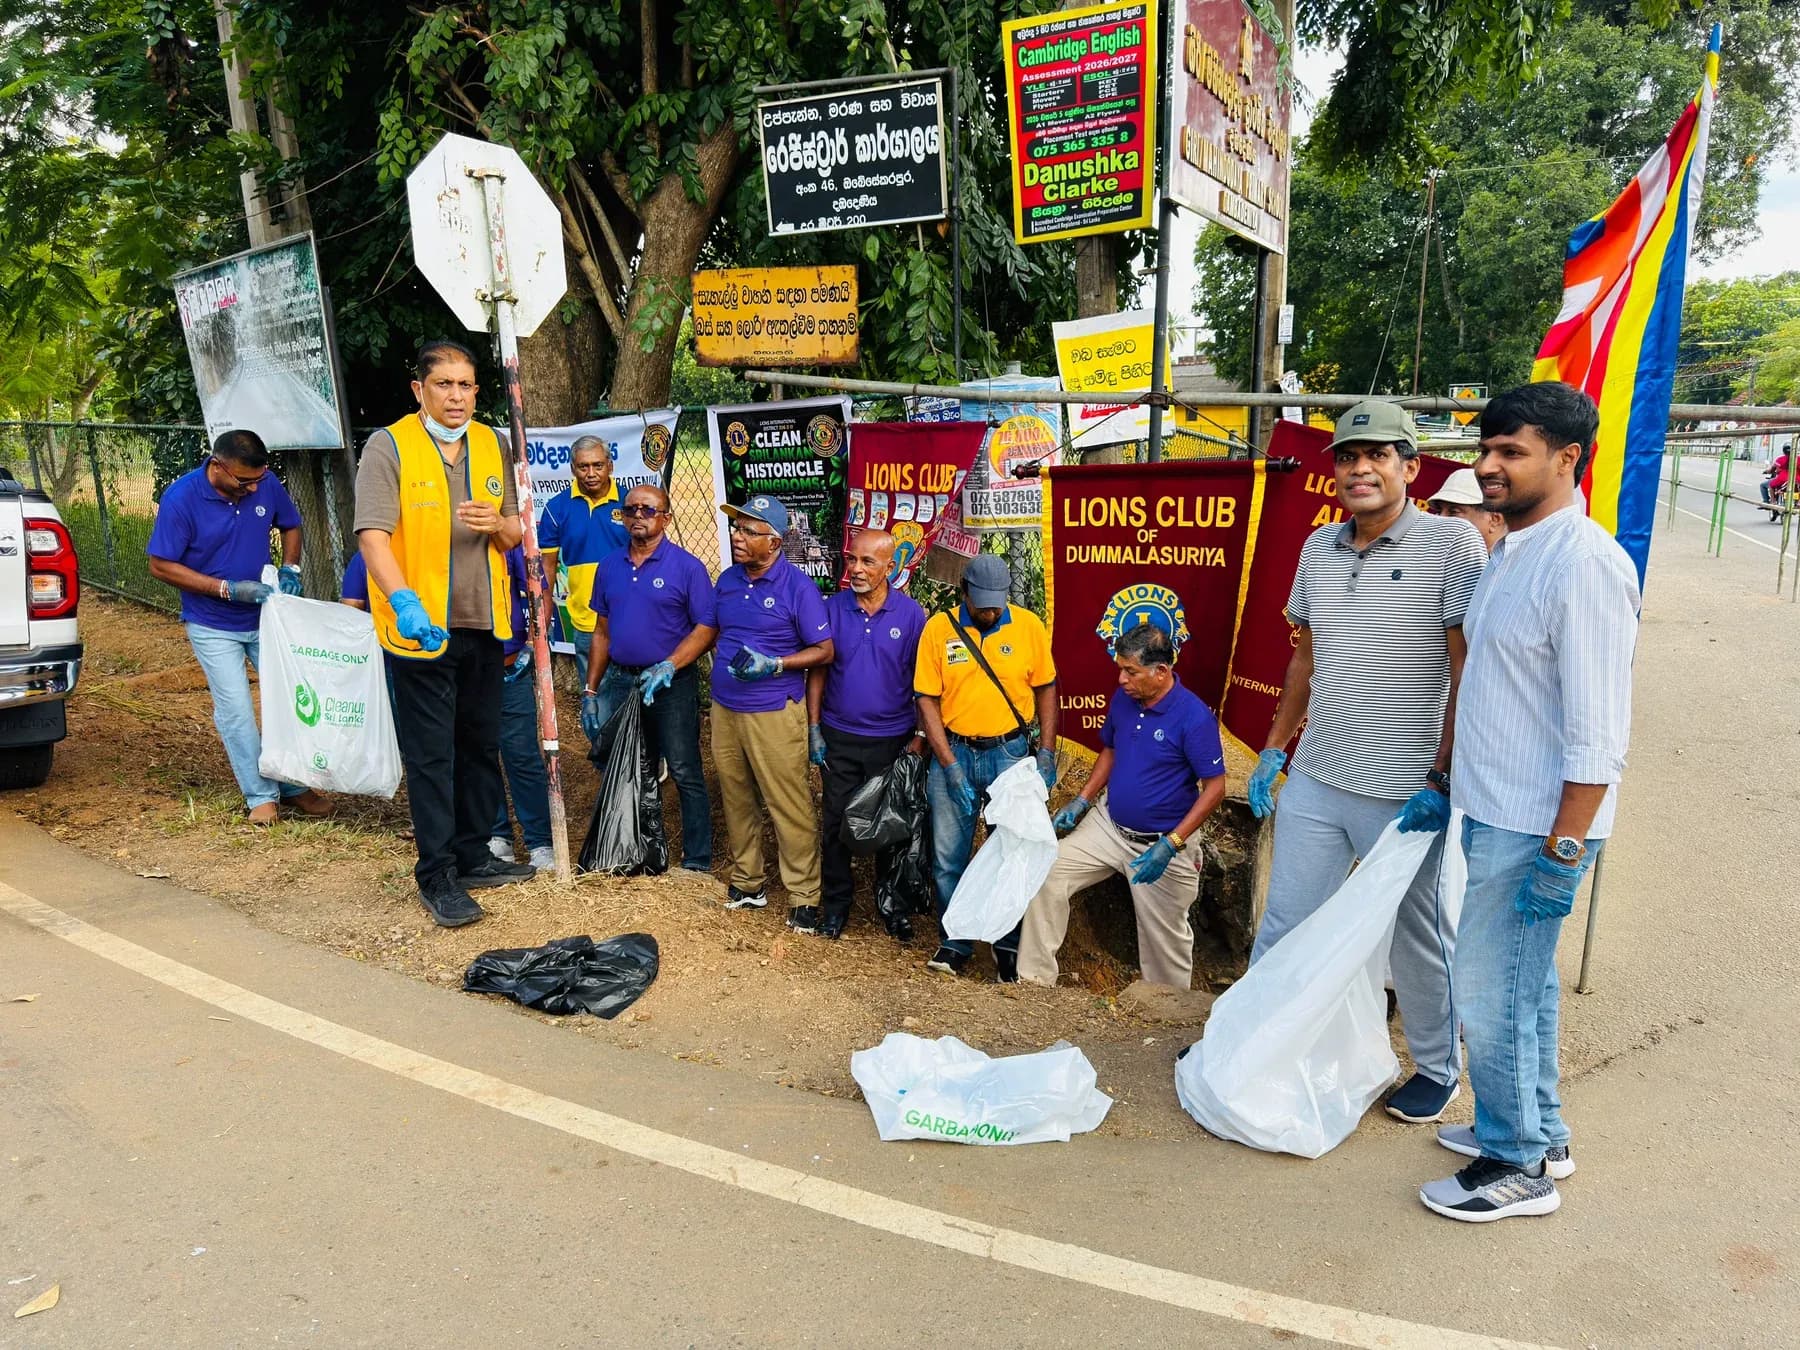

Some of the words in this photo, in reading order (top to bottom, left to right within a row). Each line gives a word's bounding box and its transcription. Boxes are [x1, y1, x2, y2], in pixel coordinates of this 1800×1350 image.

[1018, 37, 1088, 68] Cambridge
[1091, 24, 1141, 56] English
[1022, 65, 1082, 83] Assessment
[1084, 53, 1138, 72] 2026/2027
[763, 106, 822, 128] උප්පැන්න,
[828, 99, 863, 119] මරණ
[869, 97, 892, 113] සහ
[901, 91, 937, 109] විවාහ
[855, 122, 940, 164] කාර්යාලය
[1033, 144, 1058, 158] 075
[1062, 139, 1086, 152] 365
[1091, 134, 1115, 148] 335
[1119, 131, 1129, 143] 8
[1024, 149, 1139, 187] Danushka
[795, 182, 817, 196] අංක
[820, 179, 838, 192] 46,
[1043, 176, 1119, 201] Clarke
[832, 194, 878, 213] දඹදෙණිය
[697, 282, 739, 310] සැහැල්ලු
[742, 284, 772, 305] වාහන
[776, 287, 807, 308] සඳහා
[811, 281, 850, 303] පමණයි
[695, 311, 713, 336] බස්
[716, 320, 733, 336] සහ
[736, 315, 762, 339] ලොරි
[818, 313, 857, 336] තහනම්
[755, 430, 801, 448] CLEAN
[745, 460, 824, 478] HISTORICLE
[865, 462, 914, 491] LIONS
[919, 463, 957, 493] CLUB
[752, 477, 820, 490] KINGDOMS
[1064, 497, 1147, 527] LIONS
[1156, 496, 1236, 528] CLUB
[1137, 529, 1158, 543] OF
[1066, 546, 1226, 567] DUMMALASURIYA
[1118, 586, 1176, 606] LIONS
[290, 644, 339, 661] GARBAGE
[342, 654, 369, 664] ONLY
[1060, 694, 1106, 710] LIONS
